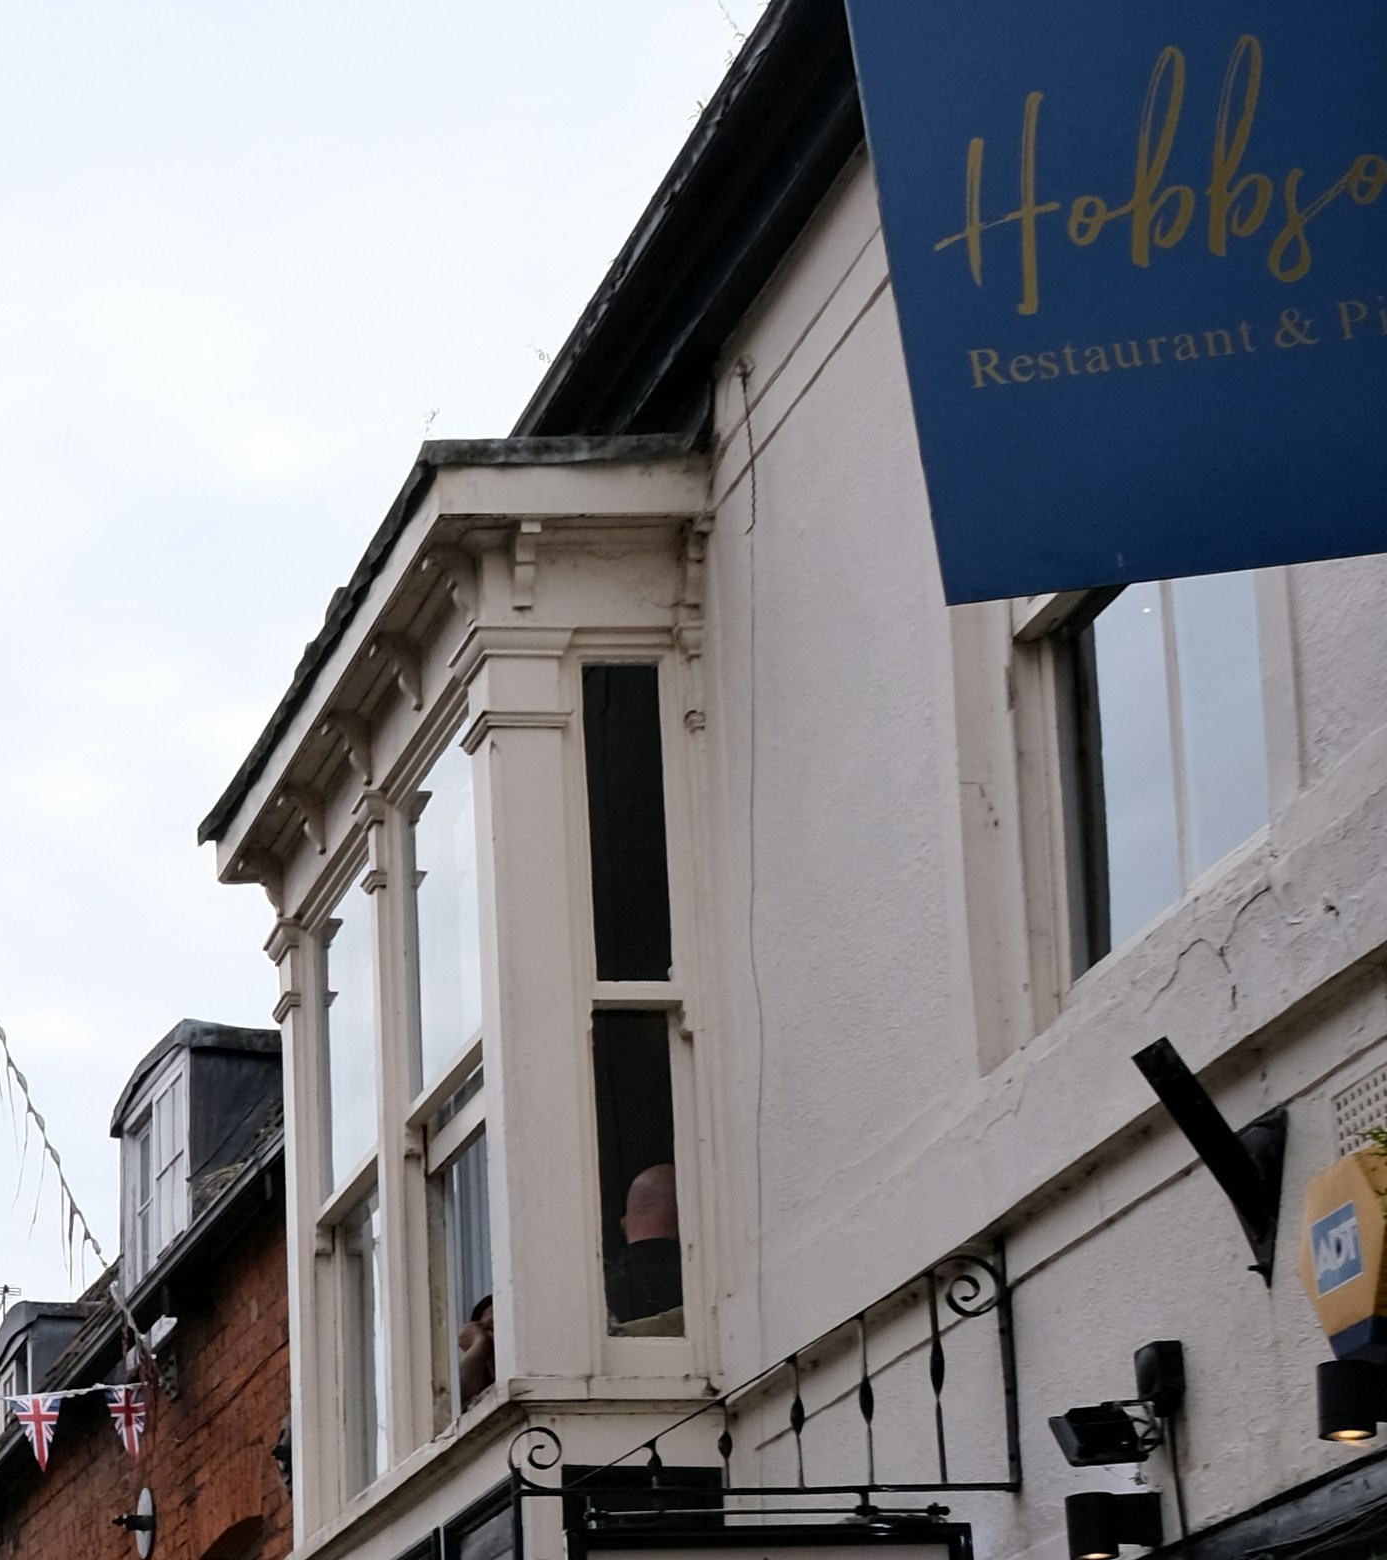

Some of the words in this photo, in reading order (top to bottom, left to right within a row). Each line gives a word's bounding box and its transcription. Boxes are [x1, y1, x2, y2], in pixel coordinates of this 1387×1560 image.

[967, 323, 1256, 390] Restaurant
[1273, 308, 1321, 349] &
[1317, 1217, 1358, 1279] ADT
